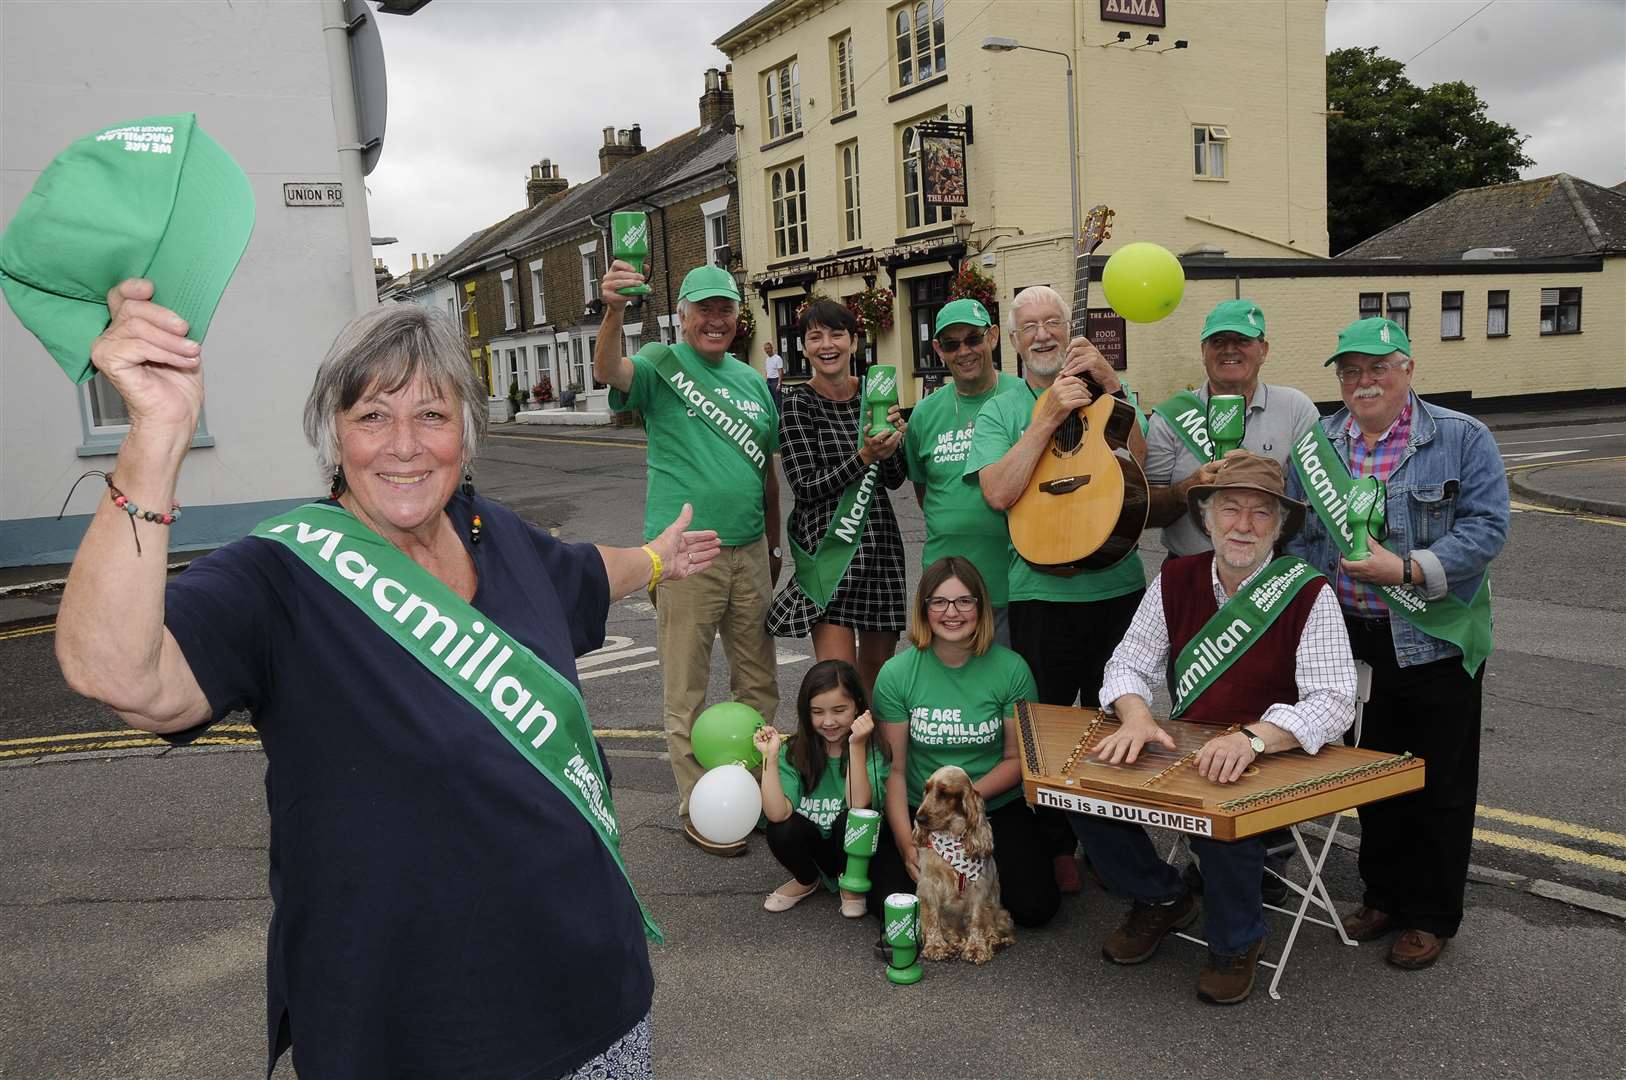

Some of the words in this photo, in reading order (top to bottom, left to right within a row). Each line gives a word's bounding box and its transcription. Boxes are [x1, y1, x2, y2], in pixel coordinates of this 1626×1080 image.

[1106, 0, 1159, 18] ALMA
[124, 141, 150, 152] ARE
[152, 143, 172, 154] WE
[288, 190, 322, 200] UNION
[327, 190, 342, 200] RD
[944, 194, 964, 203] ALMA
[816, 262, 840, 280] THE
[842, 255, 877, 276] ALMA
[670, 372, 766, 469] Macmillan
[938, 431, 953, 444] WE
[934, 453, 965, 463] CANCER
[1250, 587, 1264, 602] WE
[1262, 590, 1283, 612] CANCER
[1390, 592, 1418, 612] SUPPORT
[269, 522, 557, 750] Macmillan
[910, 708, 929, 720] WE
[932, 709, 961, 722] ARE
[947, 733, 996, 745] SUPPORT
[564, 768, 590, 803] CANCER
[800, 796, 820, 812] WE
[1038, 792, 1072, 808] This
[1078, 798, 1091, 812] is
[1097, 806, 1107, 815] a
[1112, 806, 1208, 833] DULCIMER
